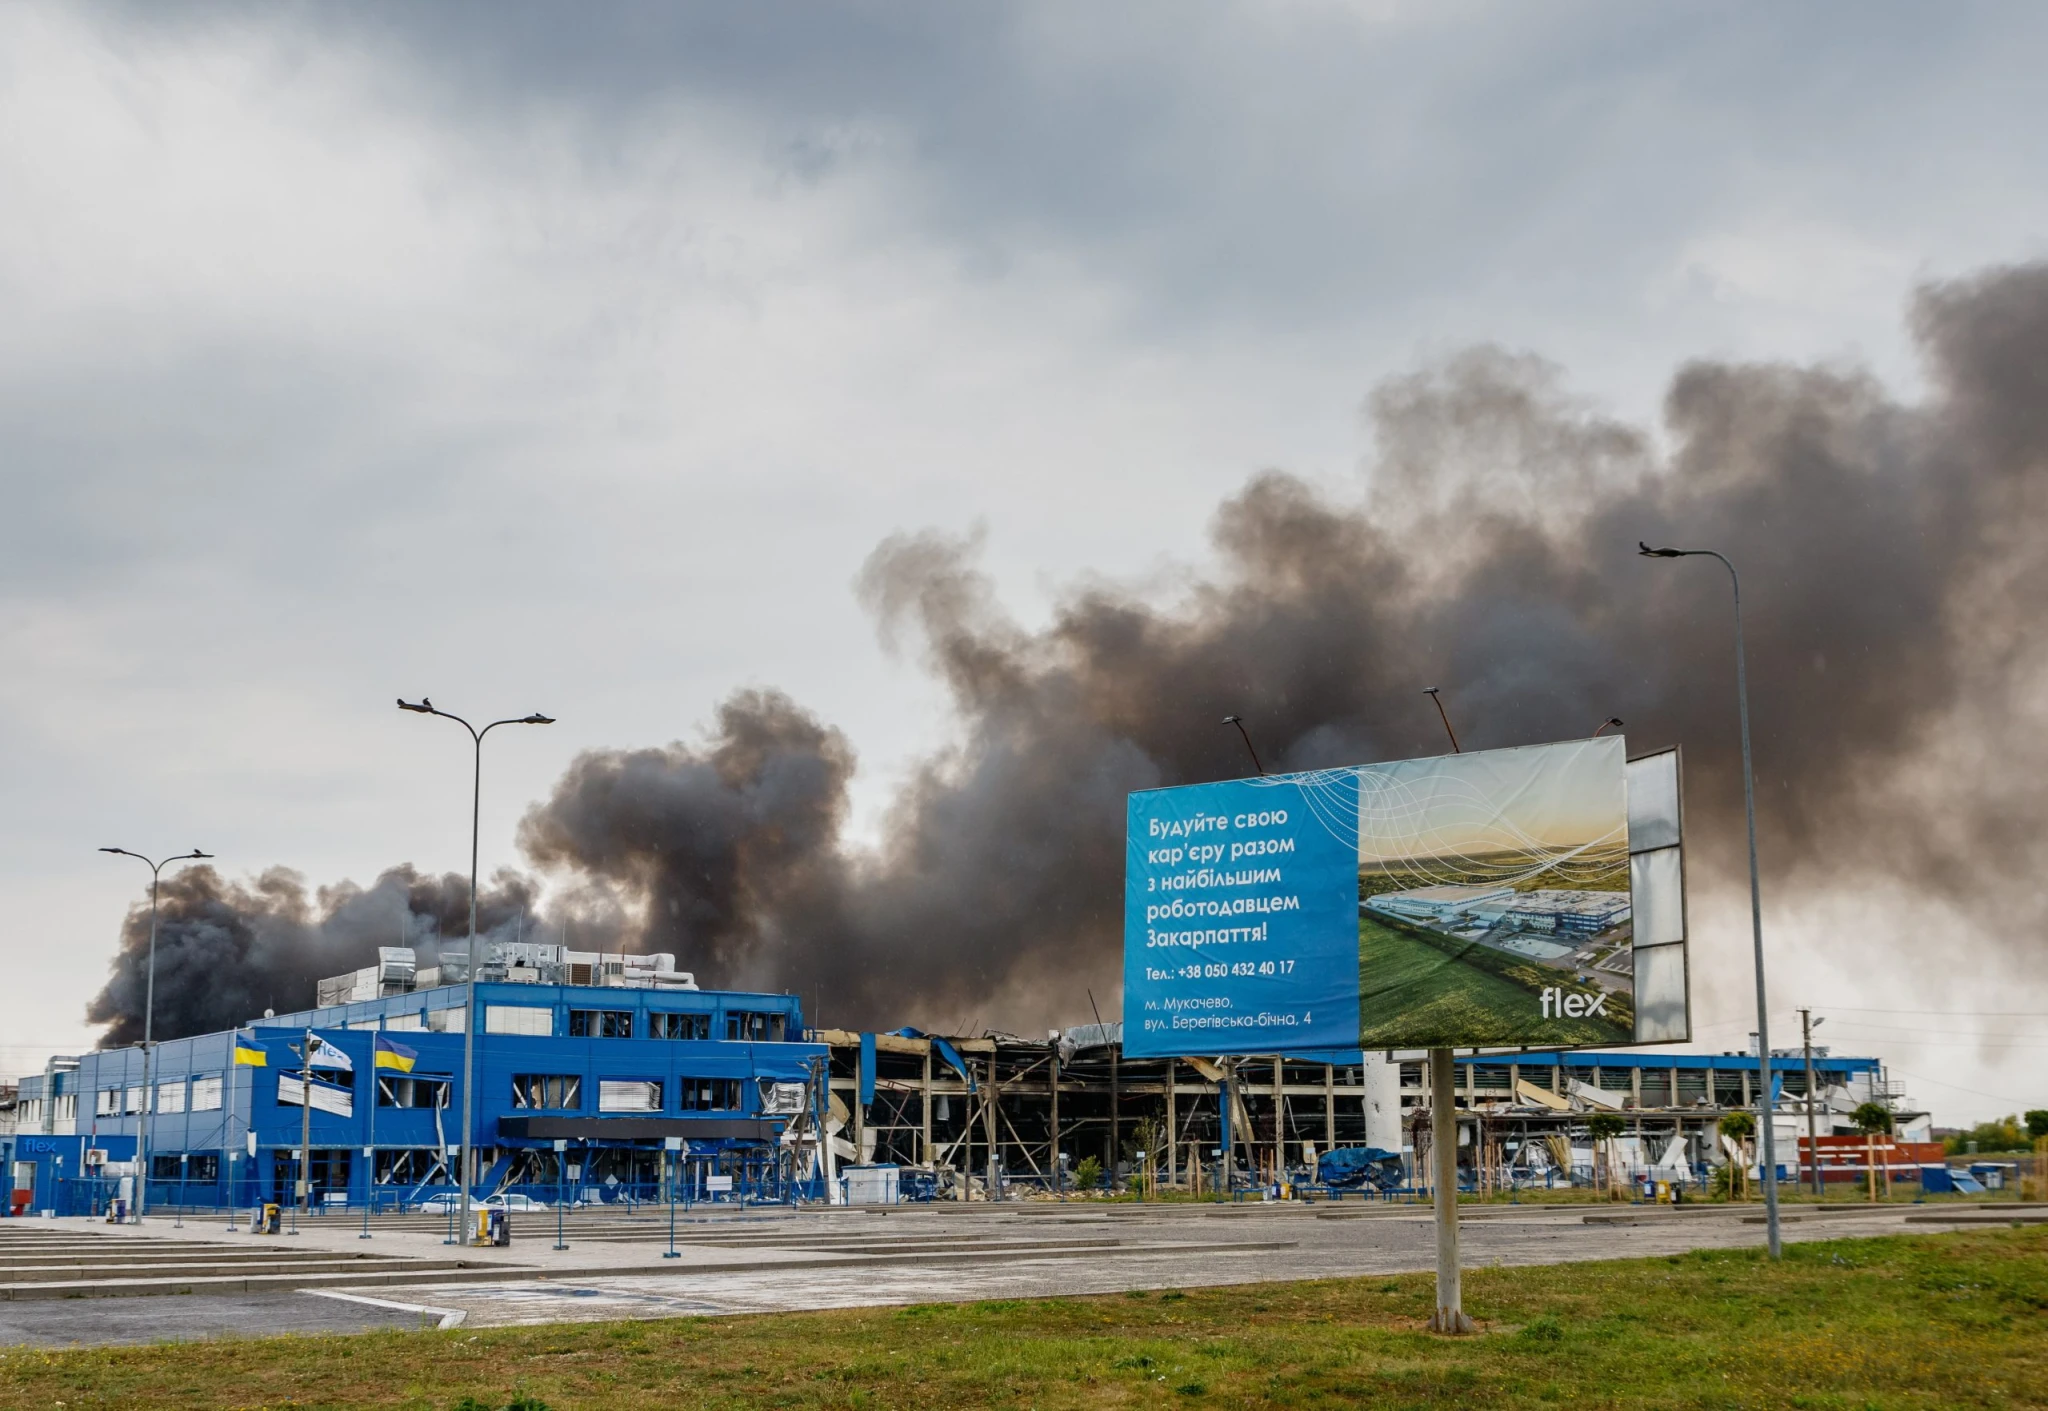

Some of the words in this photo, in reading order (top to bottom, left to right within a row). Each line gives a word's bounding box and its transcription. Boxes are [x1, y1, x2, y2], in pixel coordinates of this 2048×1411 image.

[1150, 812, 1228, 840] Будуйте
[1234, 809, 1288, 829] свою
[1231, 838, 1295, 862] разом
[1147, 877, 1156, 892] з
[1161, 868, 1281, 891] найбільшим
[1146, 895, 1300, 924] роботодавцем
[1146, 921, 1268, 950] Закарпаття!
[1146, 967, 1175, 981] Тел.:
[1178, 965, 1201, 979] +38
[1204, 964, 1228, 978] 050
[1231, 962, 1255, 976] 432
[1258, 961, 1275, 975] 40
[1279, 960, 1295, 974] 17
[1144, 1000, 1160, 1011] м.
[1163, 997, 1234, 1013] Мукачево,
[1539, 987, 1607, 1019] flex
[1144, 1018, 1169, 1033] вул.
[1172, 1011, 1300, 1031] Берегівська-бічна,
[1303, 1011, 1312, 1025] 4
[25, 1138, 56, 1152] flex
